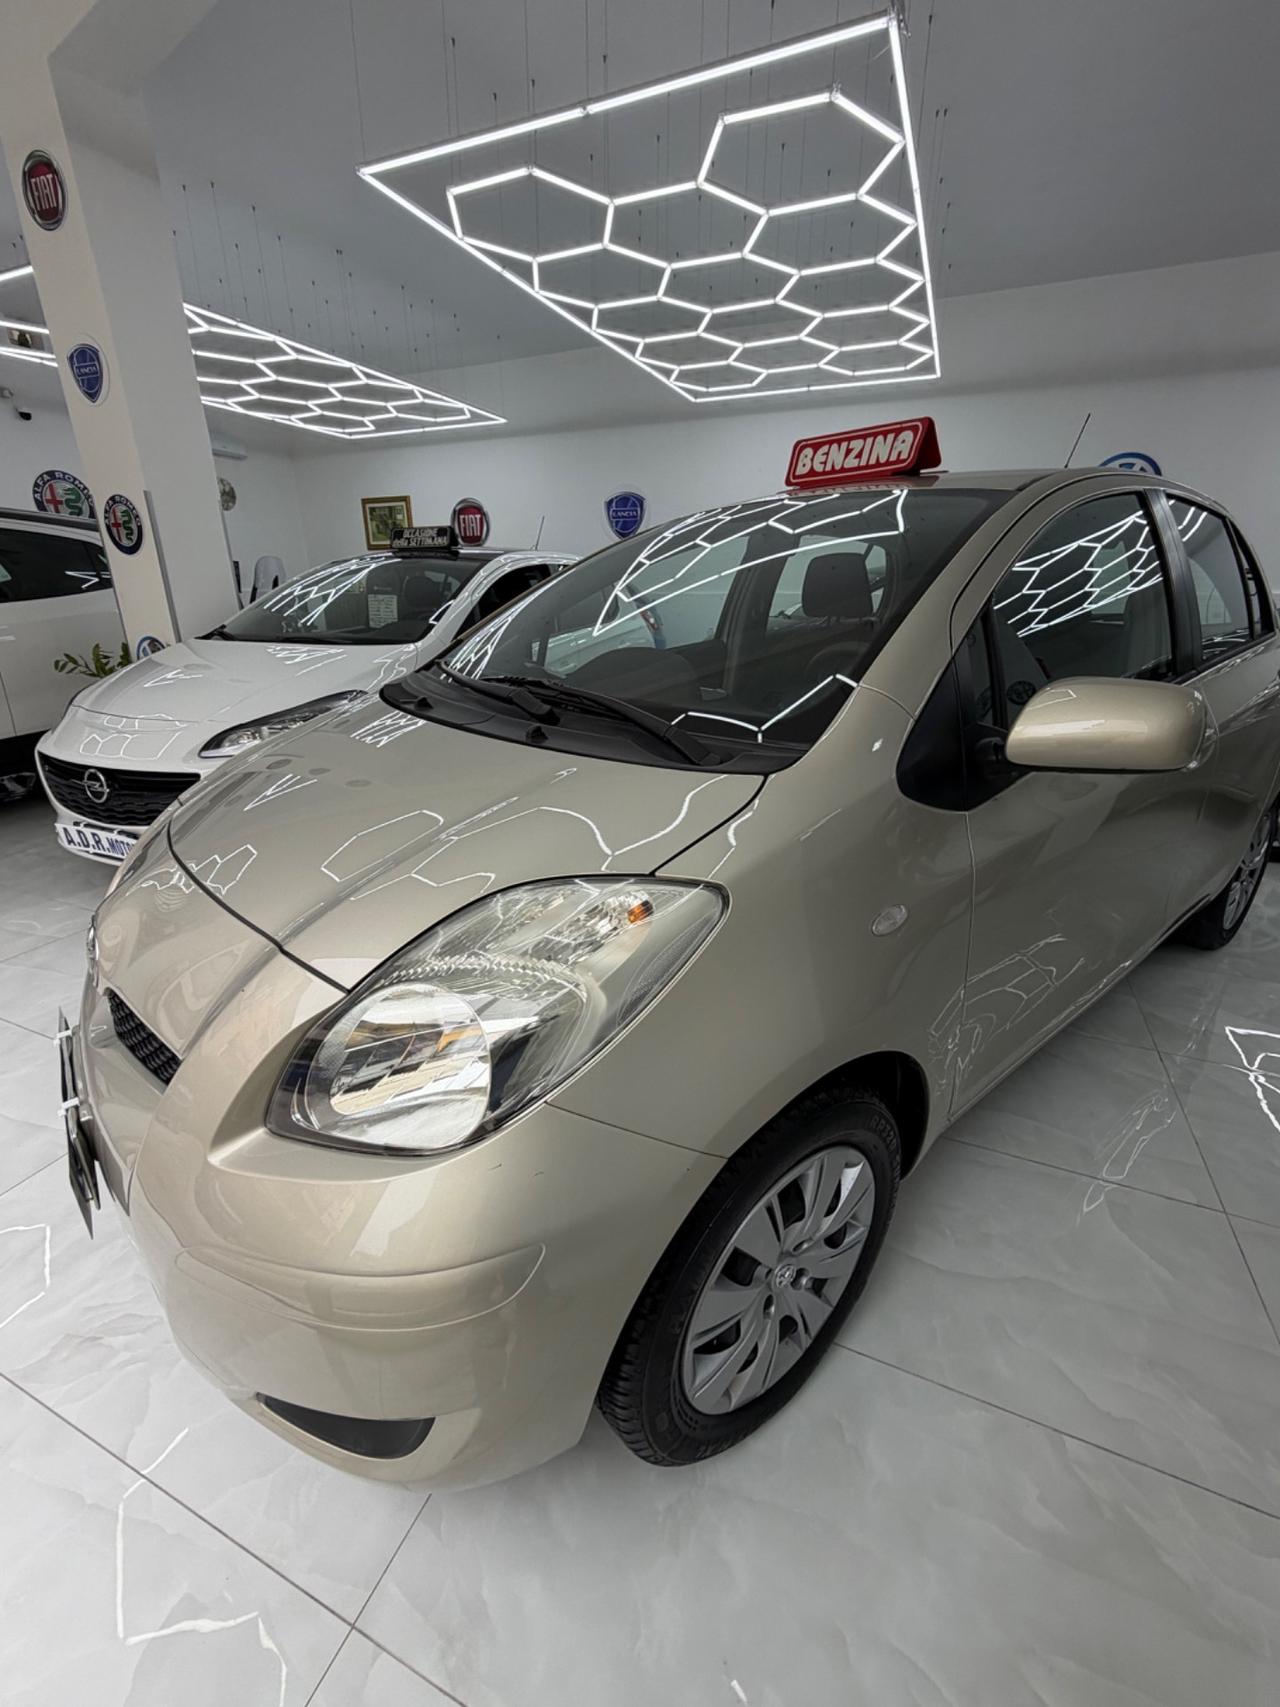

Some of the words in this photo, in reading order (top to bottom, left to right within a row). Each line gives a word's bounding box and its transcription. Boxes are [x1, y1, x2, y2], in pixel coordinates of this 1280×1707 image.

[30, 173, 58, 211] FIAT
[76, 365, 99, 376] LANCIA
[795, 431, 913, 475] BENZINA
[34, 474, 50, 500] ALFA
[612, 511, 638, 519] LANCIA
[403, 528, 438, 538] OCCASIONE
[459, 514, 482, 537] FIAT
[409, 536, 448, 546] SETTIMANA
